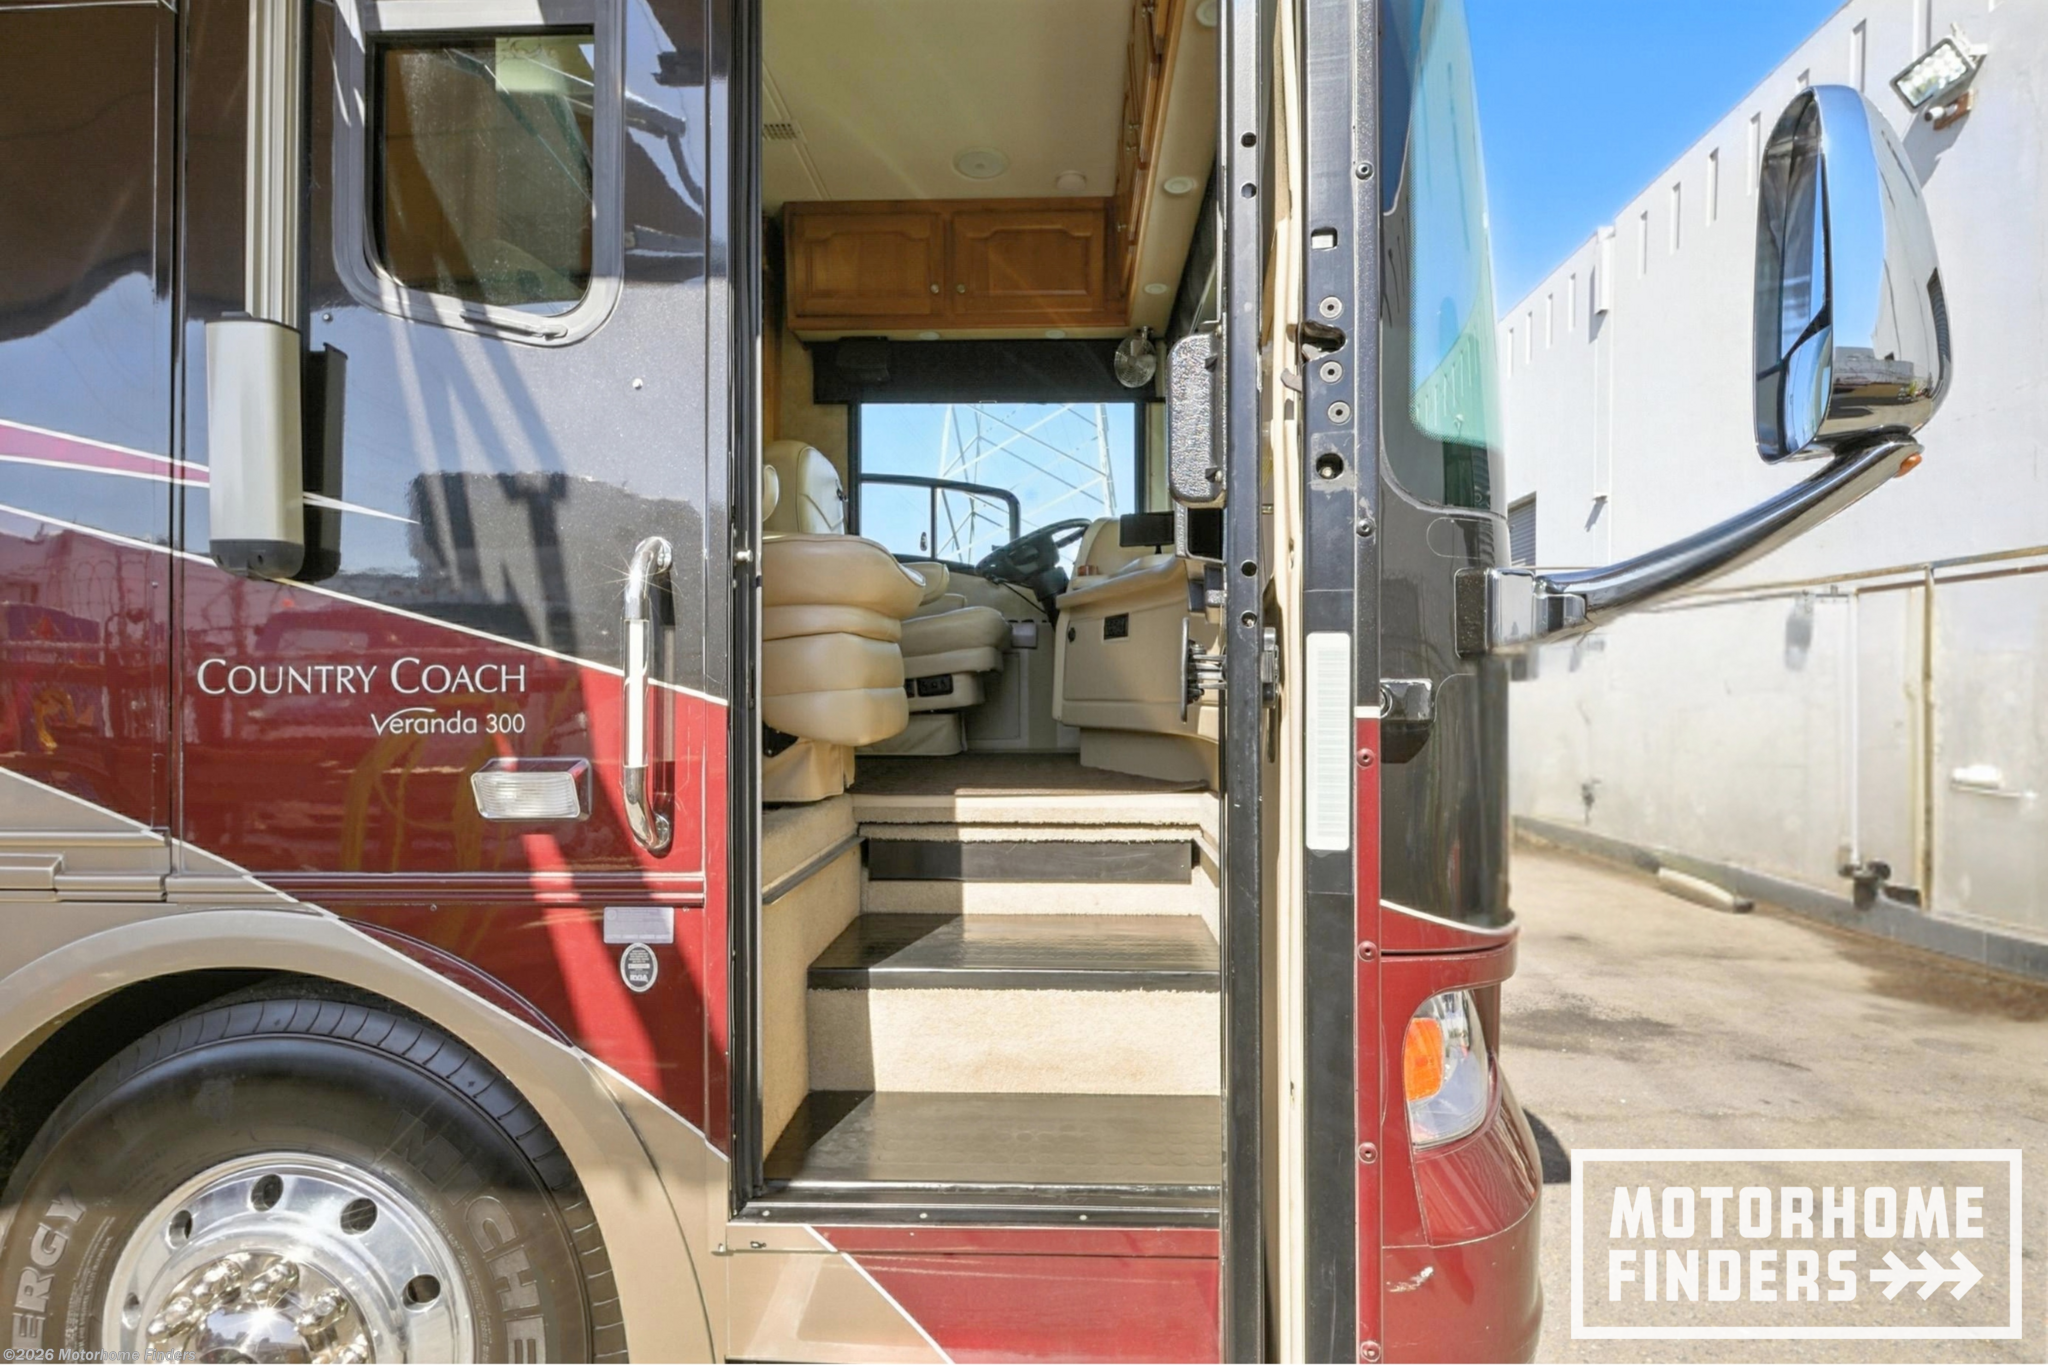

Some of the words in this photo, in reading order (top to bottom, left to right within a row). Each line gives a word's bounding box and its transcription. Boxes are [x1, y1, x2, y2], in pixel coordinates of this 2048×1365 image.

[196, 658, 378, 695] COUNTRY
[390, 656, 526, 694] COACH
[370, 707, 478, 736] Veranda
[485, 712, 526, 735] 300
[12, 1184, 90, 1363] ERGY
